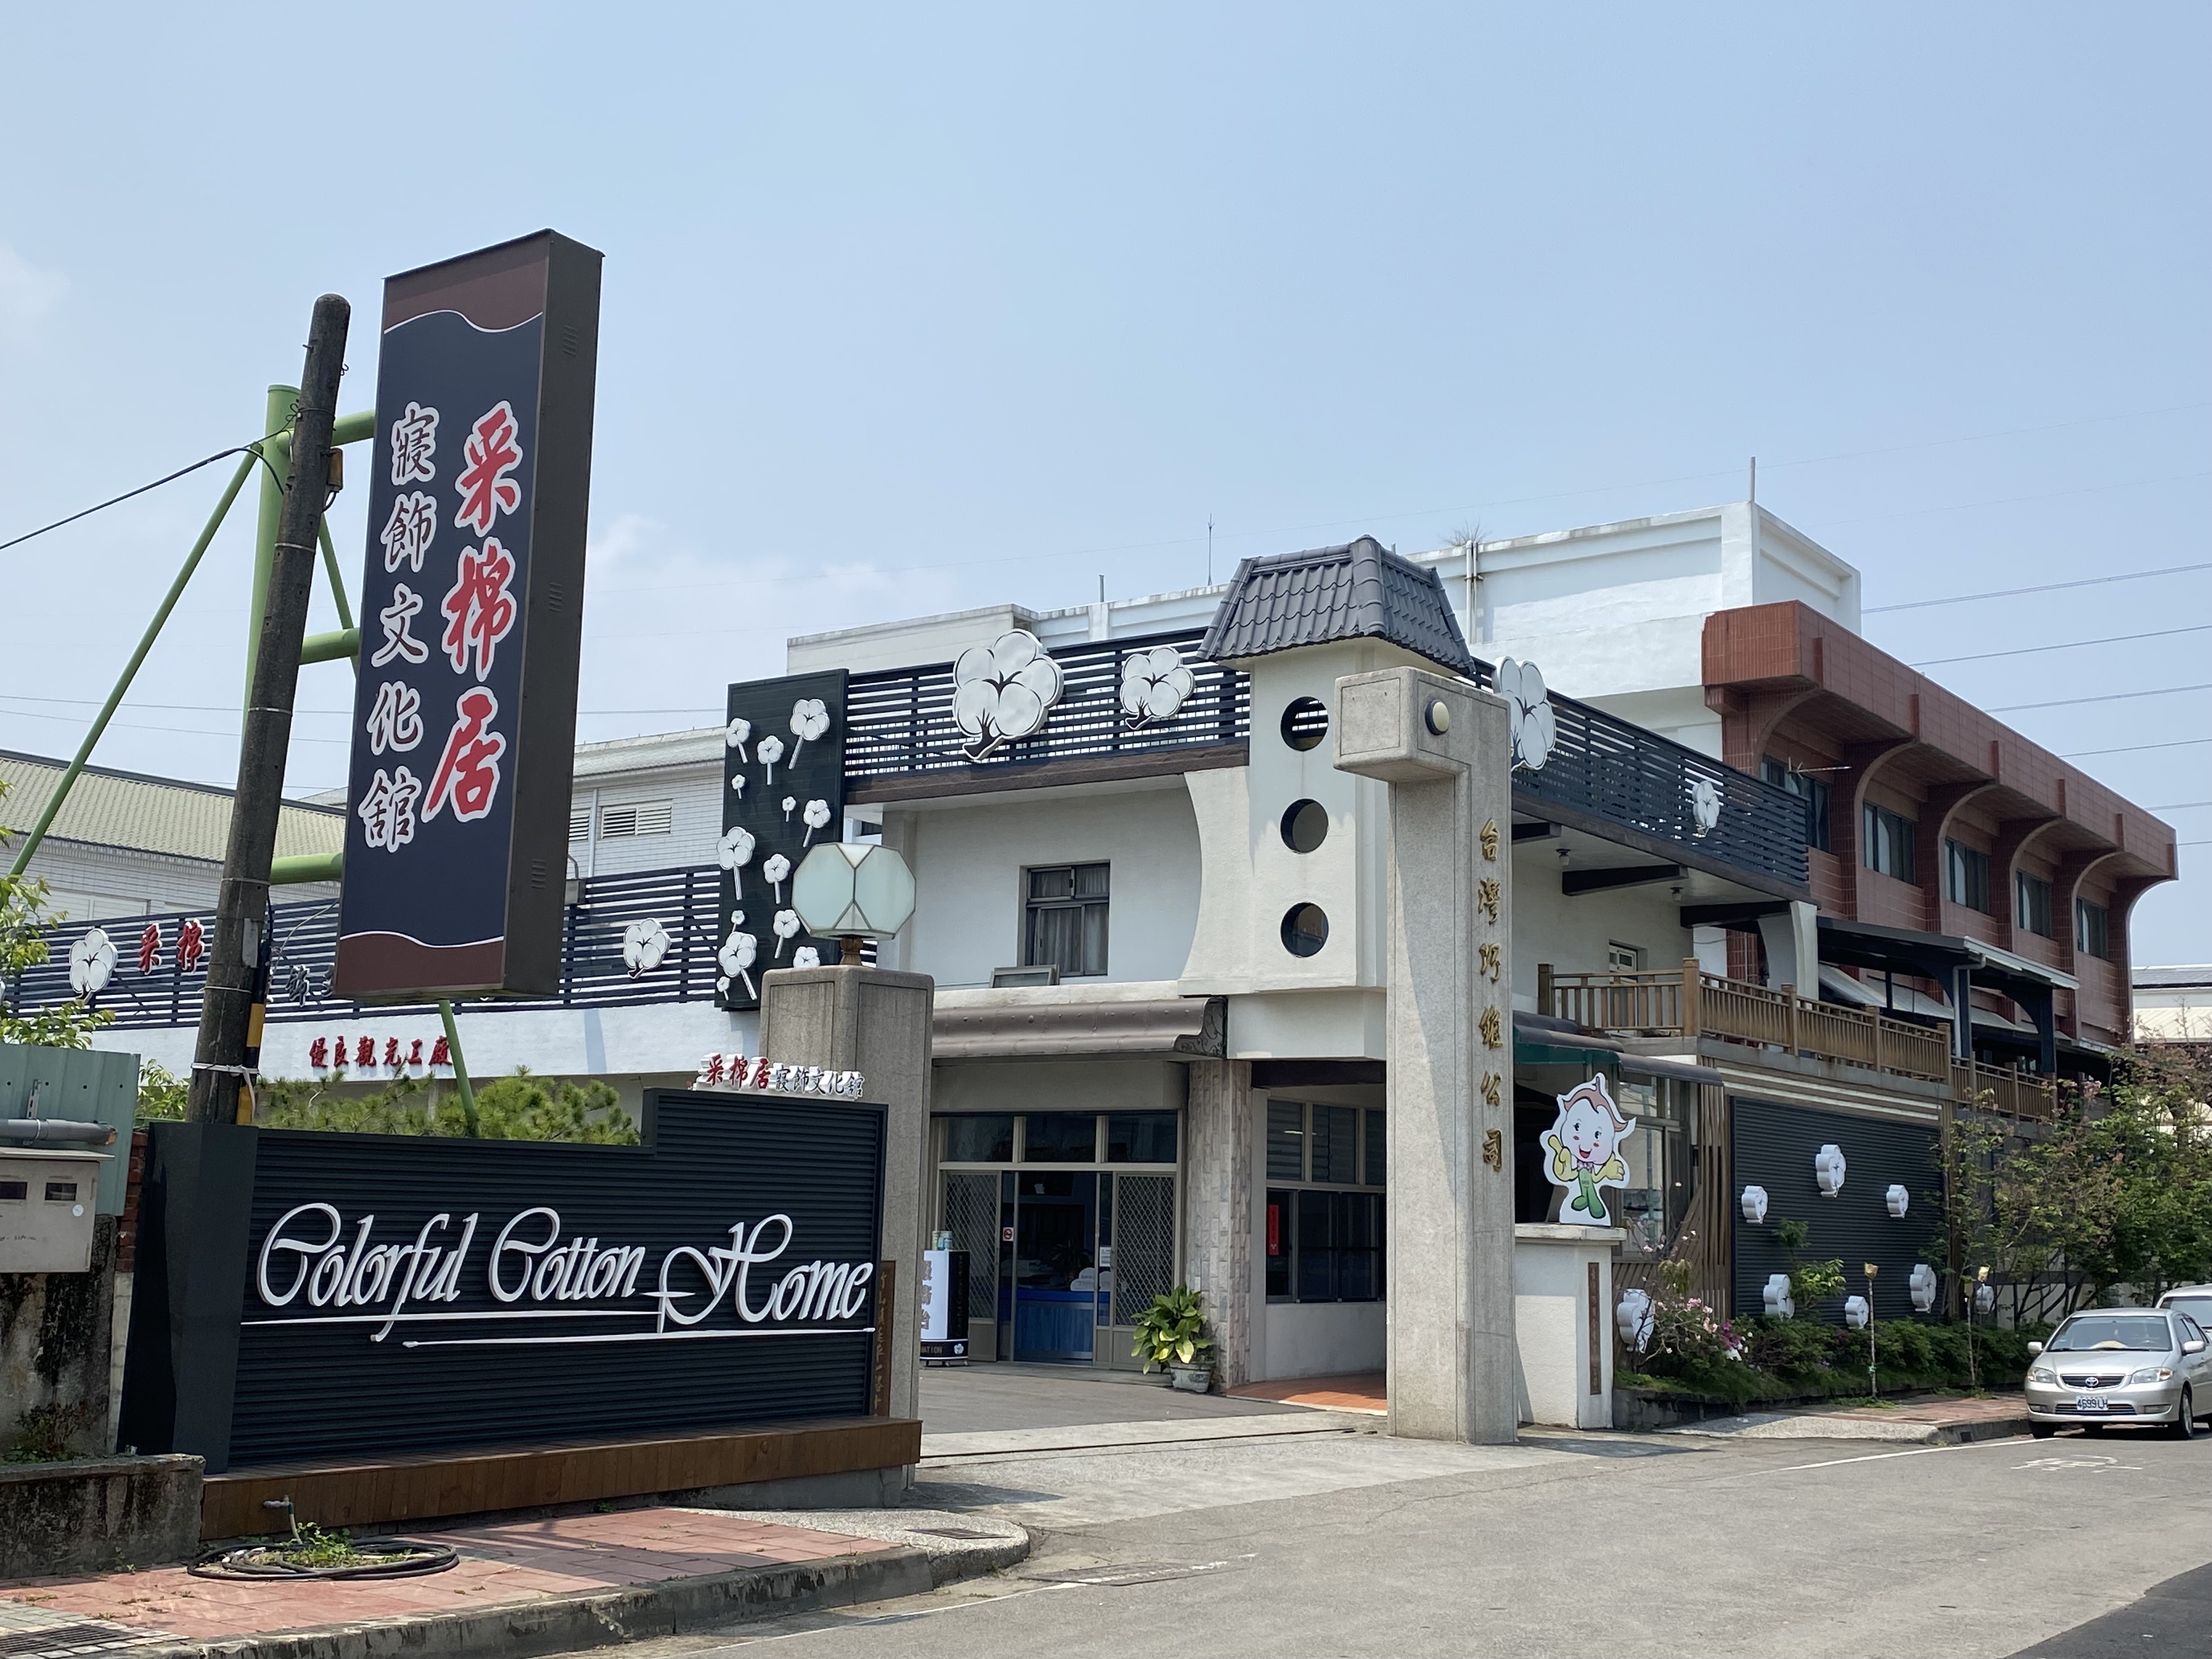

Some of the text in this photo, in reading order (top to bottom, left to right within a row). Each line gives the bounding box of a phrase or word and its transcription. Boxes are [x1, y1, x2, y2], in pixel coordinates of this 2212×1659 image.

[422, 399, 522, 823] 采棉居
[256, 1202, 478, 1342] Colorful
[489, 1206, 646, 1303] Cotton
[641, 1214, 873, 1334] Home
